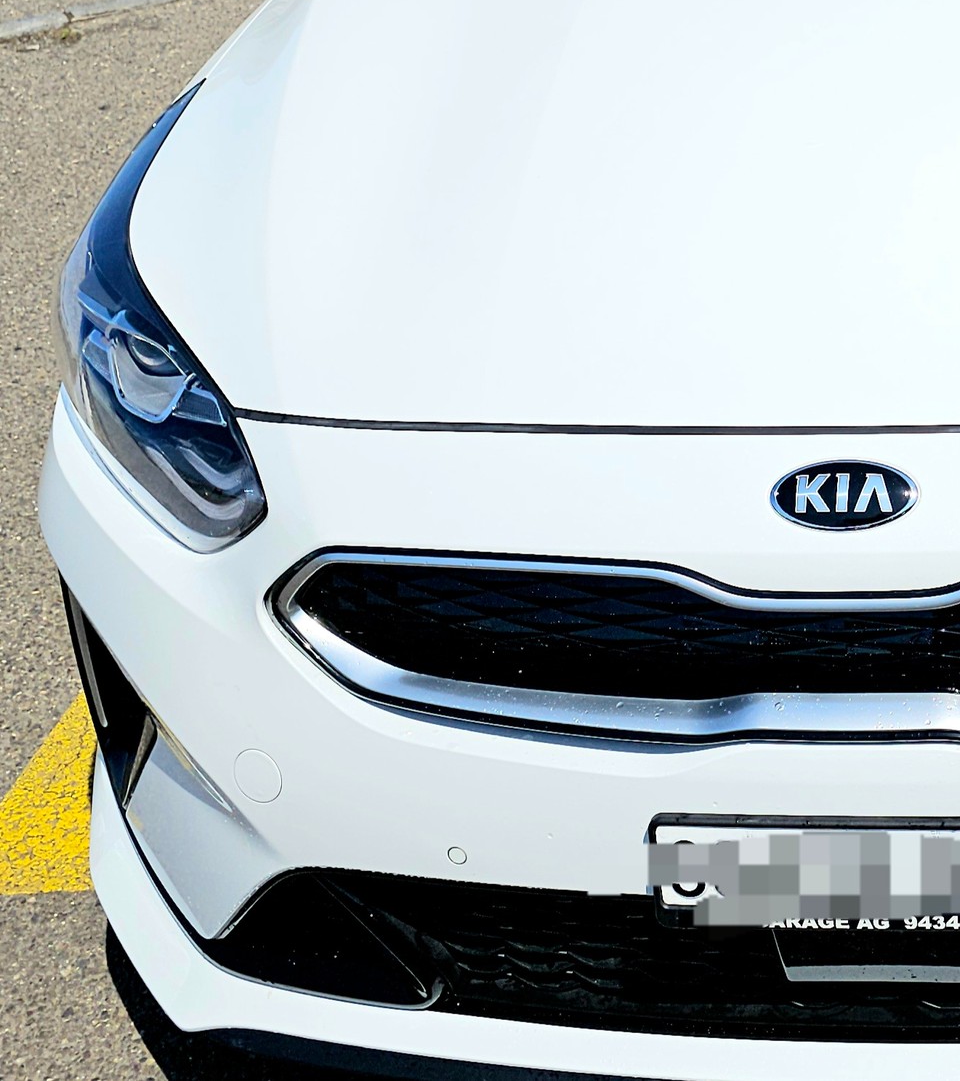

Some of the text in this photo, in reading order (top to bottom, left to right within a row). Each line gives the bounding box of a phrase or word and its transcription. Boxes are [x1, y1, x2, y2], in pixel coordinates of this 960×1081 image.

[795, 473, 893, 513] KIA
[763, 917, 850, 929] ARAGE
[857, 917, 890, 930] AG
[904, 915, 960, 930] 9434
